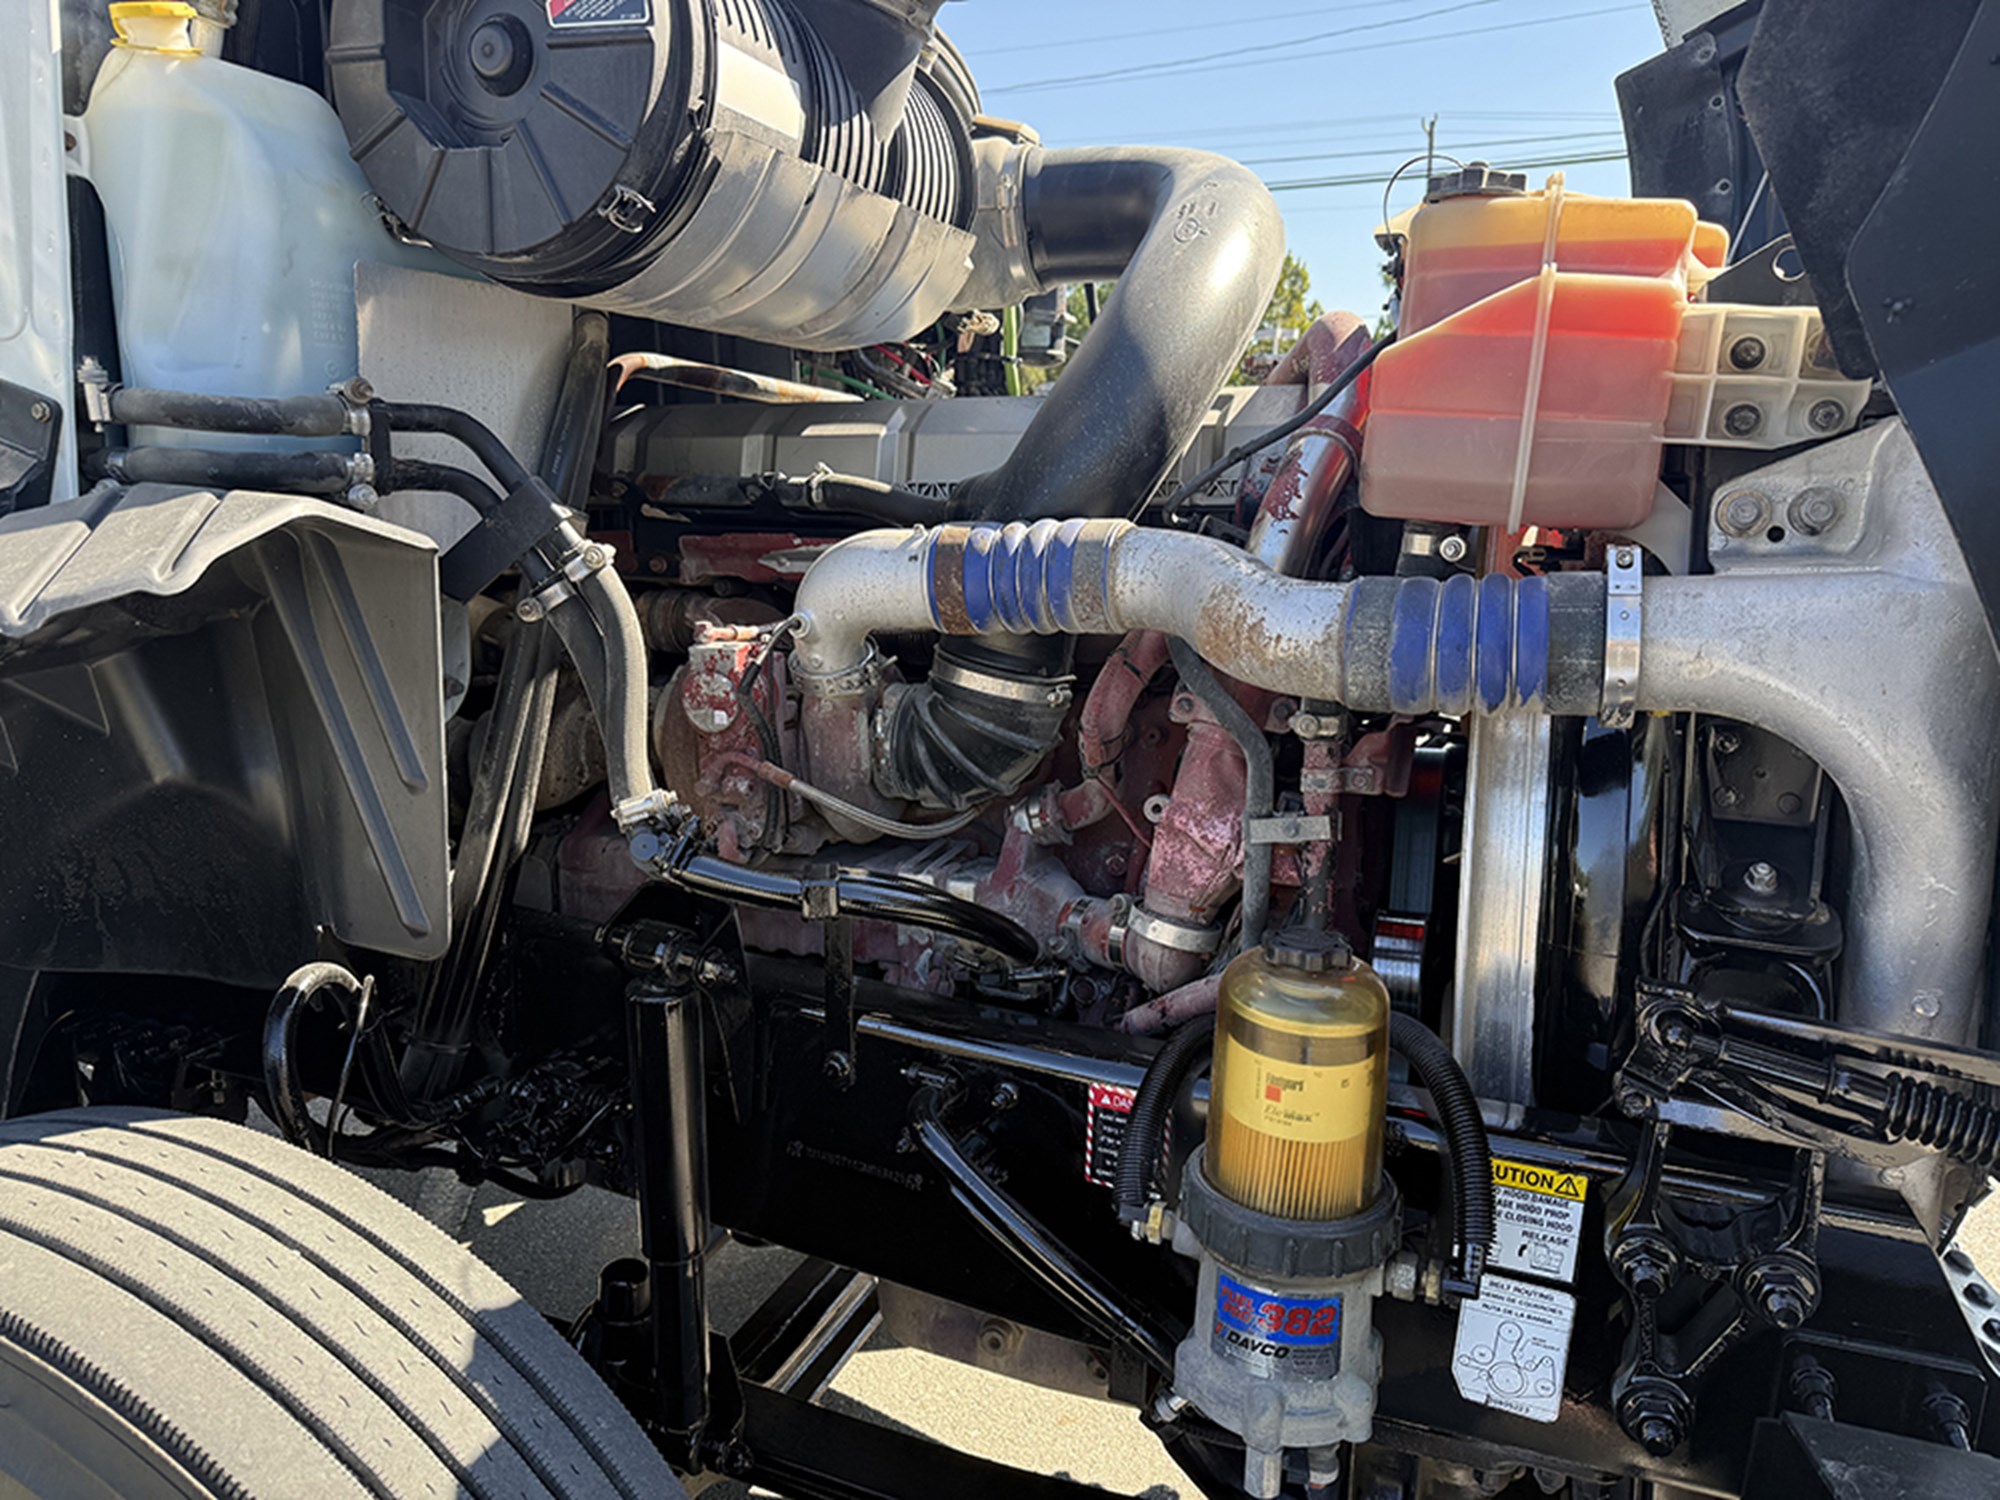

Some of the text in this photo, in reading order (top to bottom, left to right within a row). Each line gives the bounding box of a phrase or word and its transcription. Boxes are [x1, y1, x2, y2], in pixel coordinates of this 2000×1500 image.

[1113, 1095, 1133, 1110] DAN
[1495, 1164, 1555, 1190] UTION
[1505, 1211, 1544, 1227] CLOSING
[1546, 1221, 1574, 1234] HOOD
[1516, 1201, 1542, 1215] HOOD
[1545, 1208, 1571, 1221] PROP
[1521, 1230, 1569, 1247] RELEASE
[1221, 1285, 1255, 1313] FUEL
[1222, 1301, 1337, 1337] PRO 382
[1227, 1330, 1290, 1359] DAVCO
